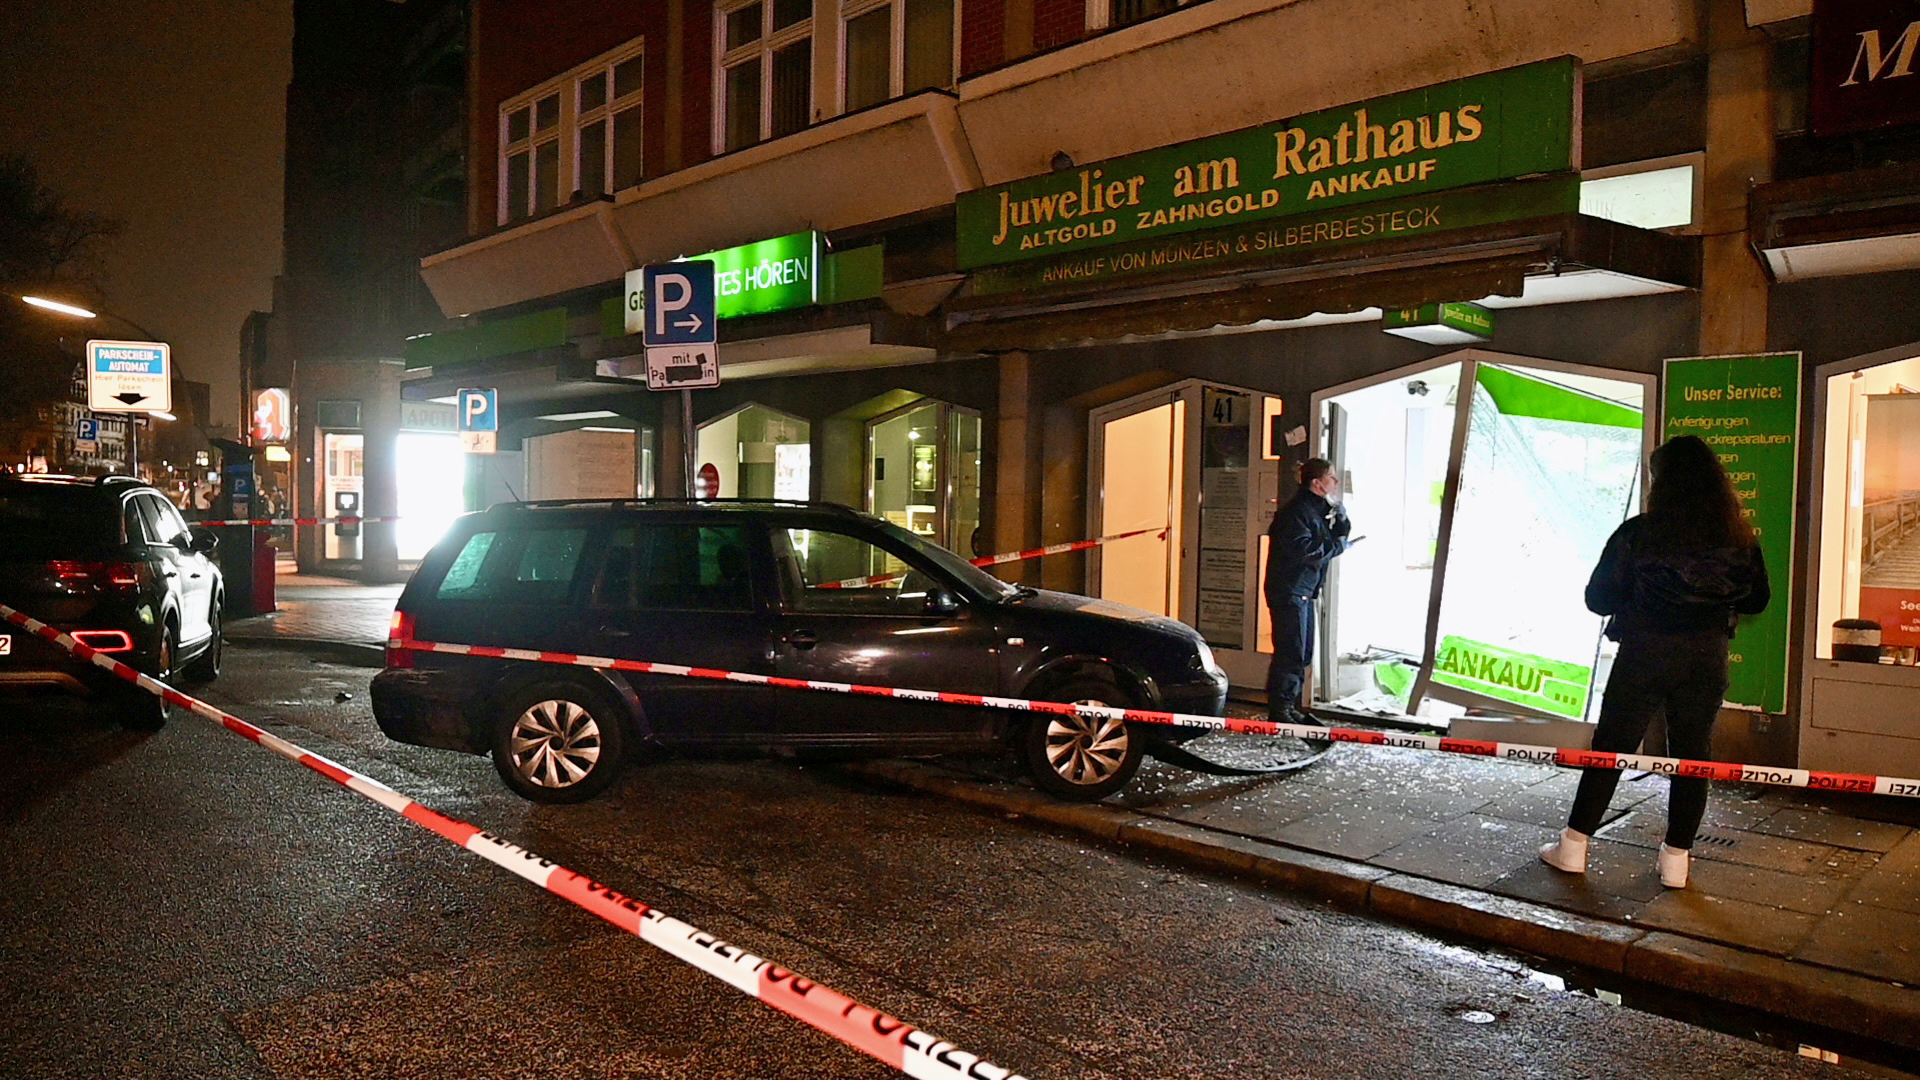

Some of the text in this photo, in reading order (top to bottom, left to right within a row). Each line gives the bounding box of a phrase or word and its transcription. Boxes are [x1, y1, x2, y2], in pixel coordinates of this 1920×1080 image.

[1839, 21, 1920, 87] M
[992, 103, 1483, 246] Juwelier am Rathaus
[1019, 158, 1437, 250] ALTGOLD ZAHNGOLD ANKAUF
[1042, 205, 1441, 283] ANKAUF VON MÜNZEN & SILBERBESTECK
[713, 268, 742, 298] TES
[744, 256, 808, 292] HÖREN
[655, 273, 692, 335] P
[98, 348, 160, 361] PARKSCHEIN-
[108, 360, 150, 373] AUTOMAT
[671, 352, 691, 365] mit
[1684, 383, 1783, 401] Unser Service:
[406, 409, 449, 428] APOT
[465, 393, 488, 427] P
[1213, 397, 1233, 423] 41
[1668, 415, 1750, 430] Anfertigungen
[79, 420, 92, 438] P
[1706, 434, 1792, 447] ckreparaturen
[1507, 748, 1565, 764] POLIZEI
[1579, 755, 1639, 770] POLIZEI
[1651, 761, 1717, 777] POLIZEI
[1729, 768, 1793, 785] POLIZEI
[1808, 775, 1876, 793] POLIZEI
